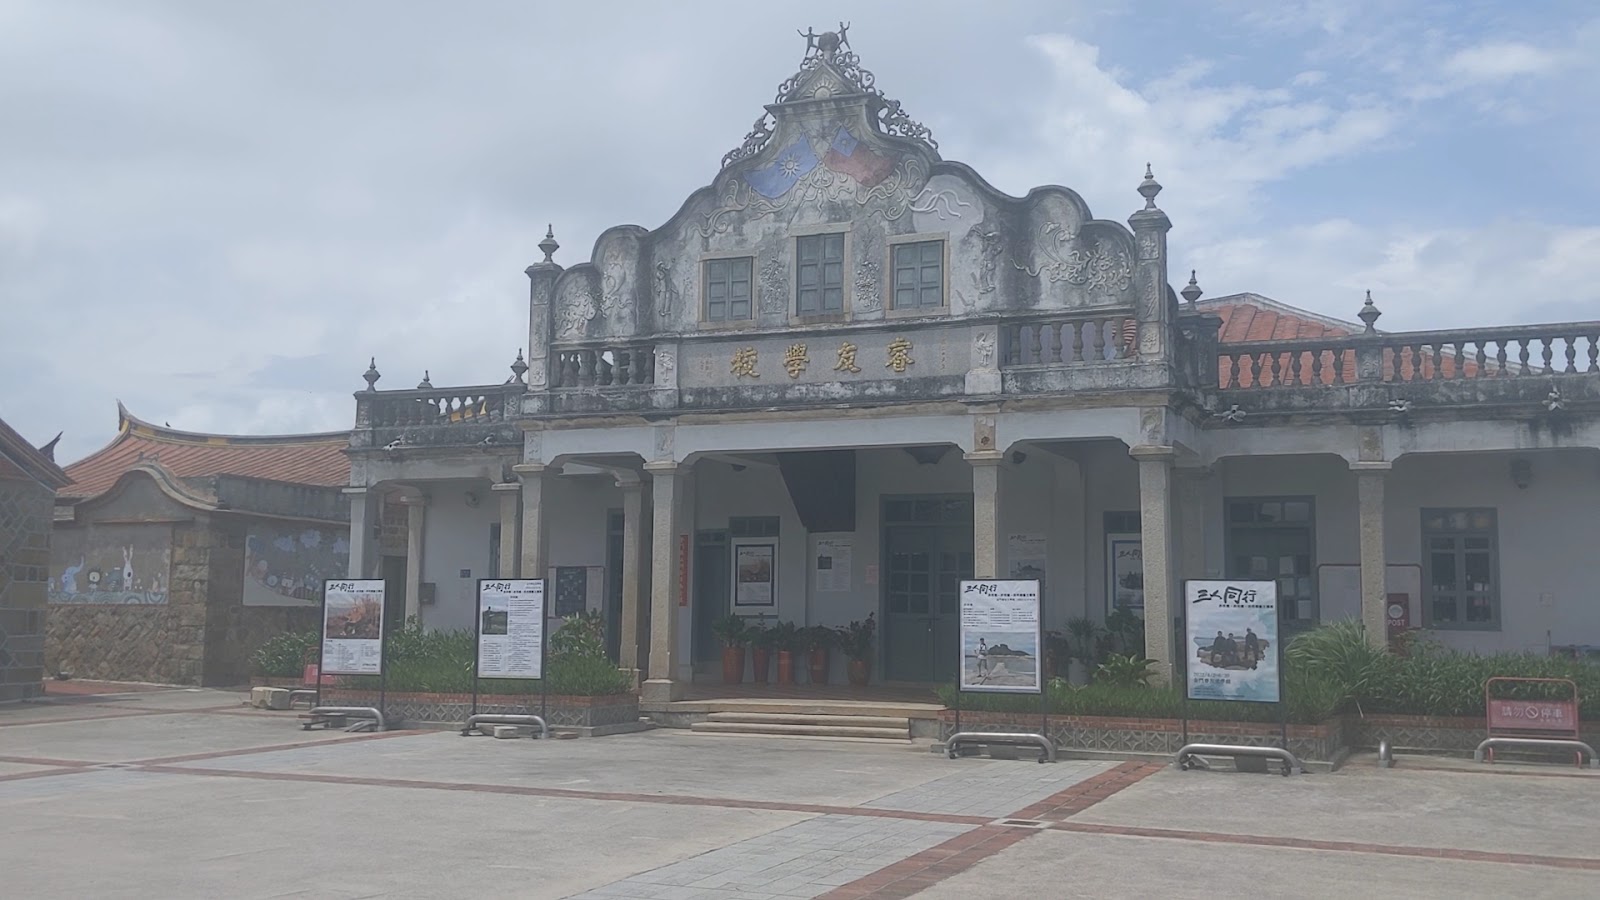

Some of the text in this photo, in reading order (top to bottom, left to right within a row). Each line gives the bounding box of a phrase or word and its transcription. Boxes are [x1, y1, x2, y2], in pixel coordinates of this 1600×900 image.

[964, 584, 998, 595] 三人同行
[1193, 586, 1257, 604] 三人同行
[1387, 619, 1405, 627] POST
[1501, 706, 1563, 718] 請勿 停車
